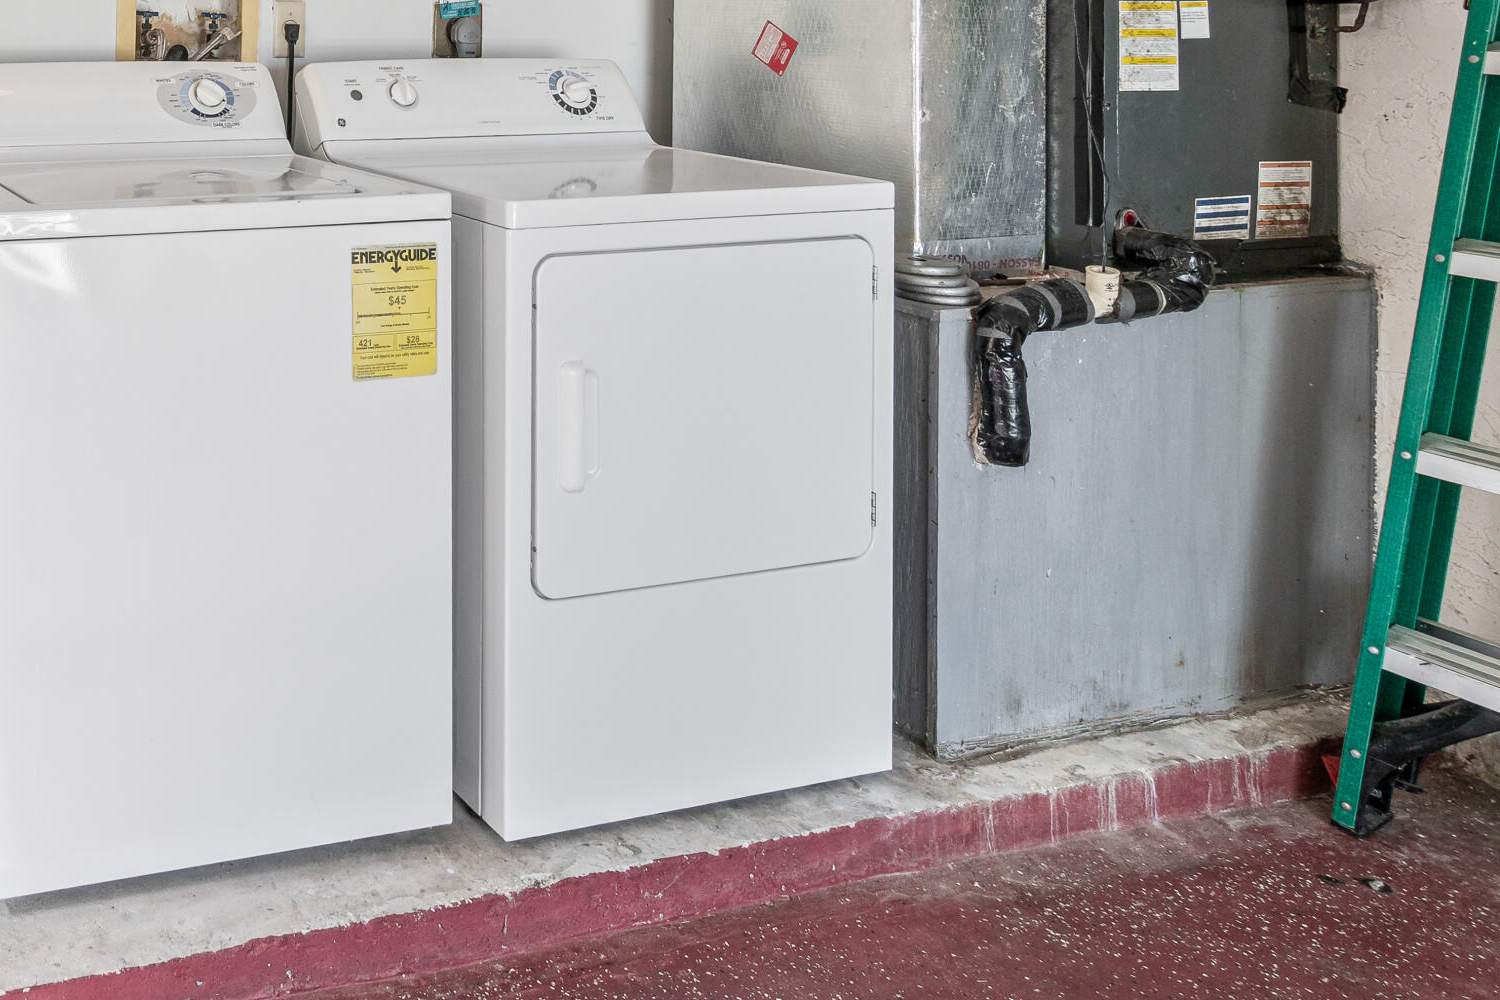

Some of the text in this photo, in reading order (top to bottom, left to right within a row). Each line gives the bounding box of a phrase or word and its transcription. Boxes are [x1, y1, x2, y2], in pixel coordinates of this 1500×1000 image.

[351, 247, 437, 268] ENERGYGUIDE
[999, 255, 1042, 271] FASSON
[388, 295, 407, 306] $45
[358, 339, 373, 347] 421
[406, 335, 420, 344] $28
